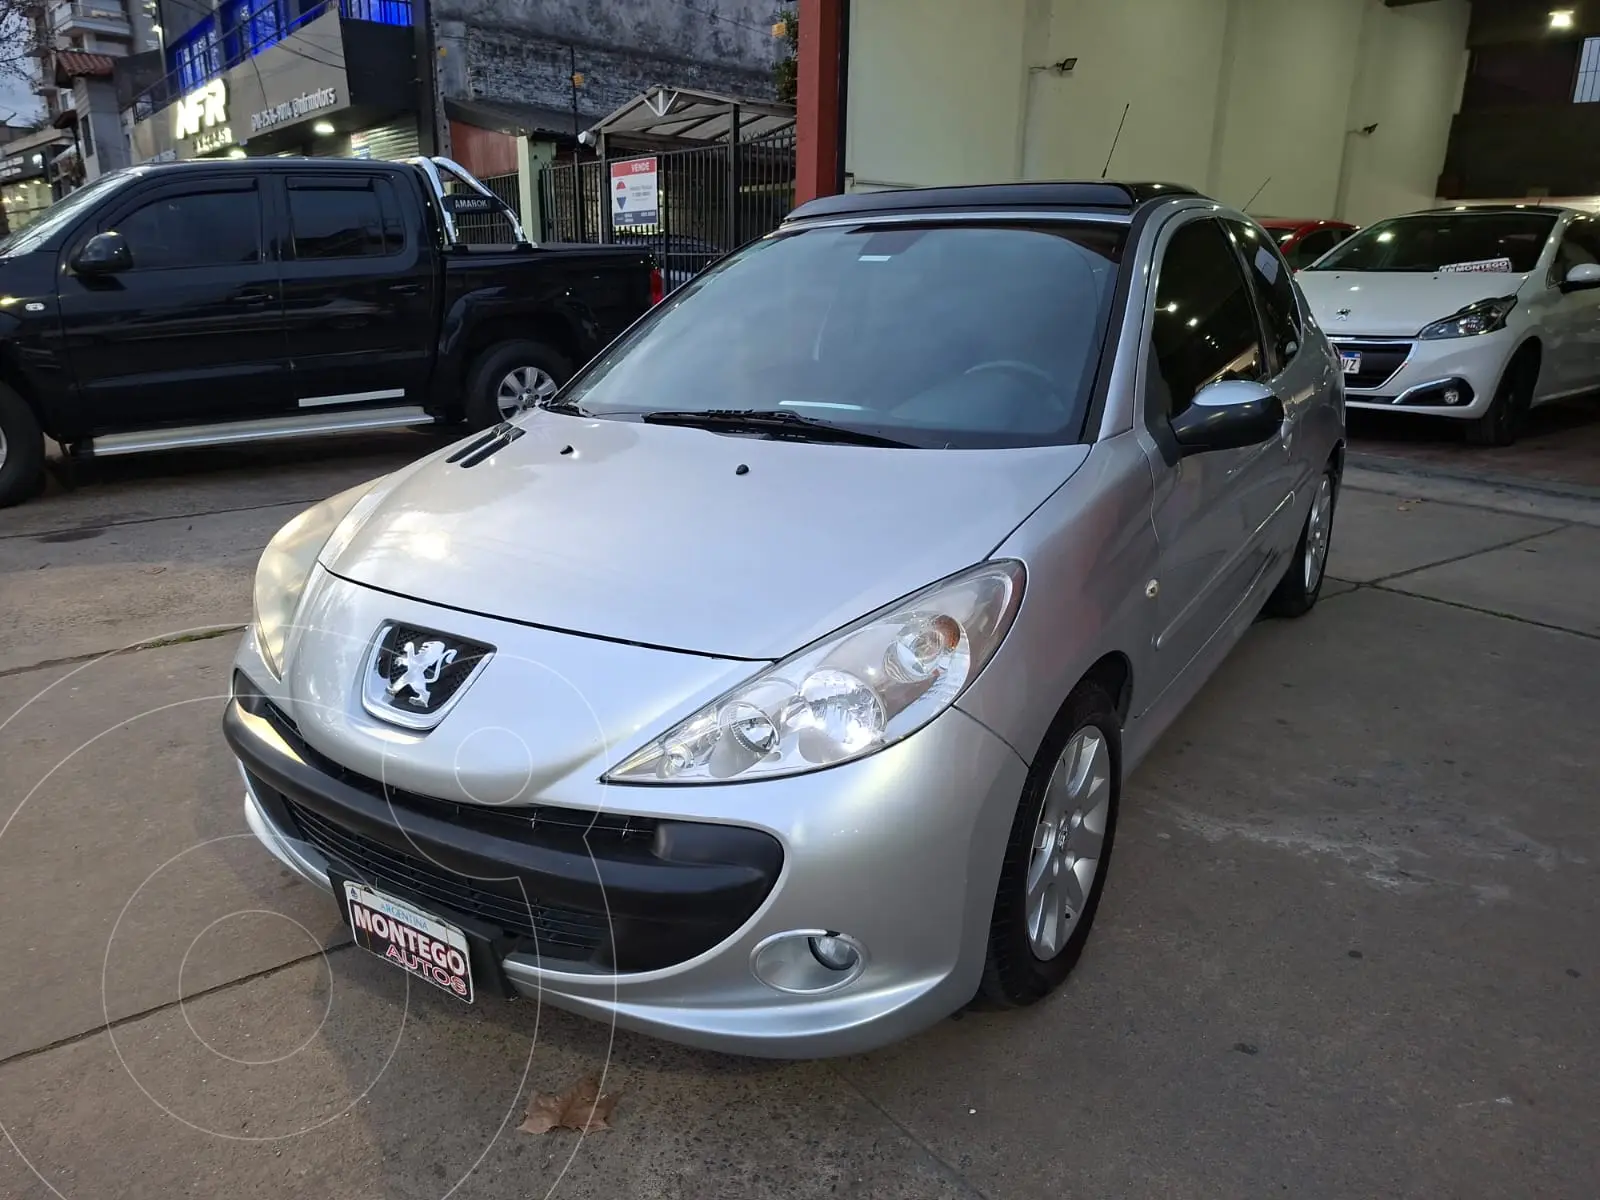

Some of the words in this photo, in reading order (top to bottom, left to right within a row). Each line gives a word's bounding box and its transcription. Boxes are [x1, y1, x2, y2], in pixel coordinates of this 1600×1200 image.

[631, 162, 650, 172] VENDE
[455, 200, 487, 209] AMAROK
[382, 904, 428, 930] ARGENTINA
[354, 905, 465, 976] MONTEGO
[385, 944, 468, 996] AUTOS
